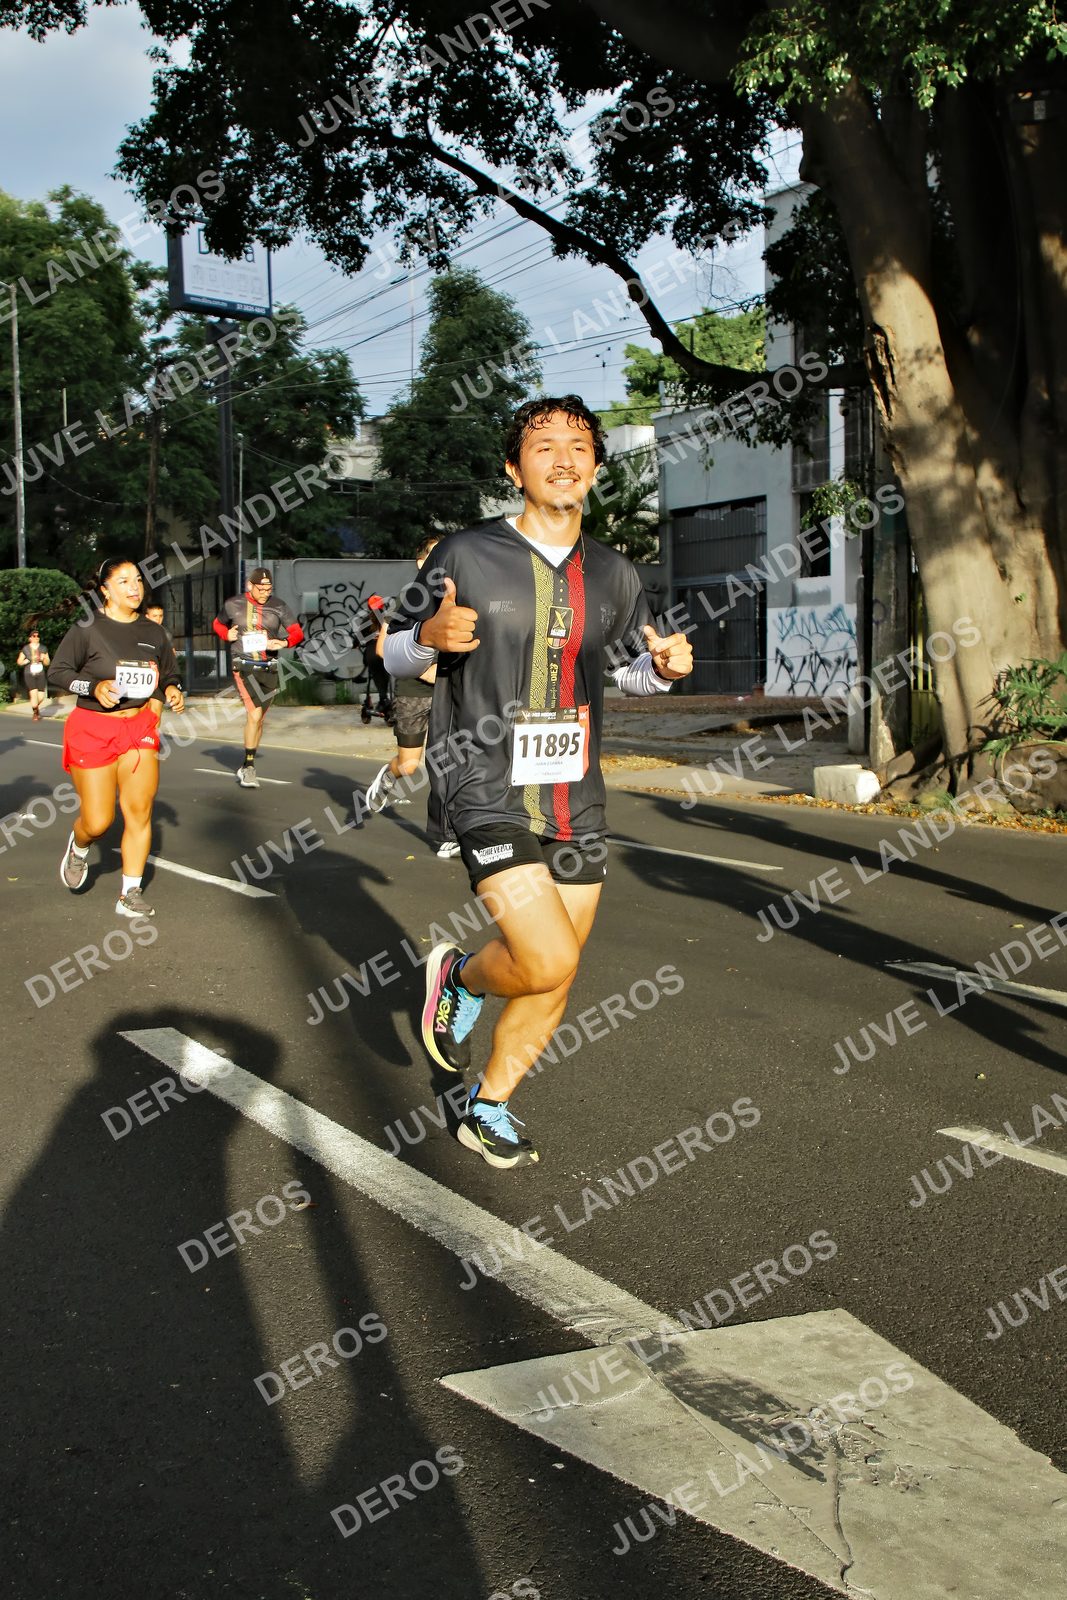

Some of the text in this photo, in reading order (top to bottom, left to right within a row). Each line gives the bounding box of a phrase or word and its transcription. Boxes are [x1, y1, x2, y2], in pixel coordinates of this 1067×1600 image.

[320, 581, 365, 598] TOY
[519, 732, 580, 758] 11895
[435, 988, 453, 1033] HOKA
